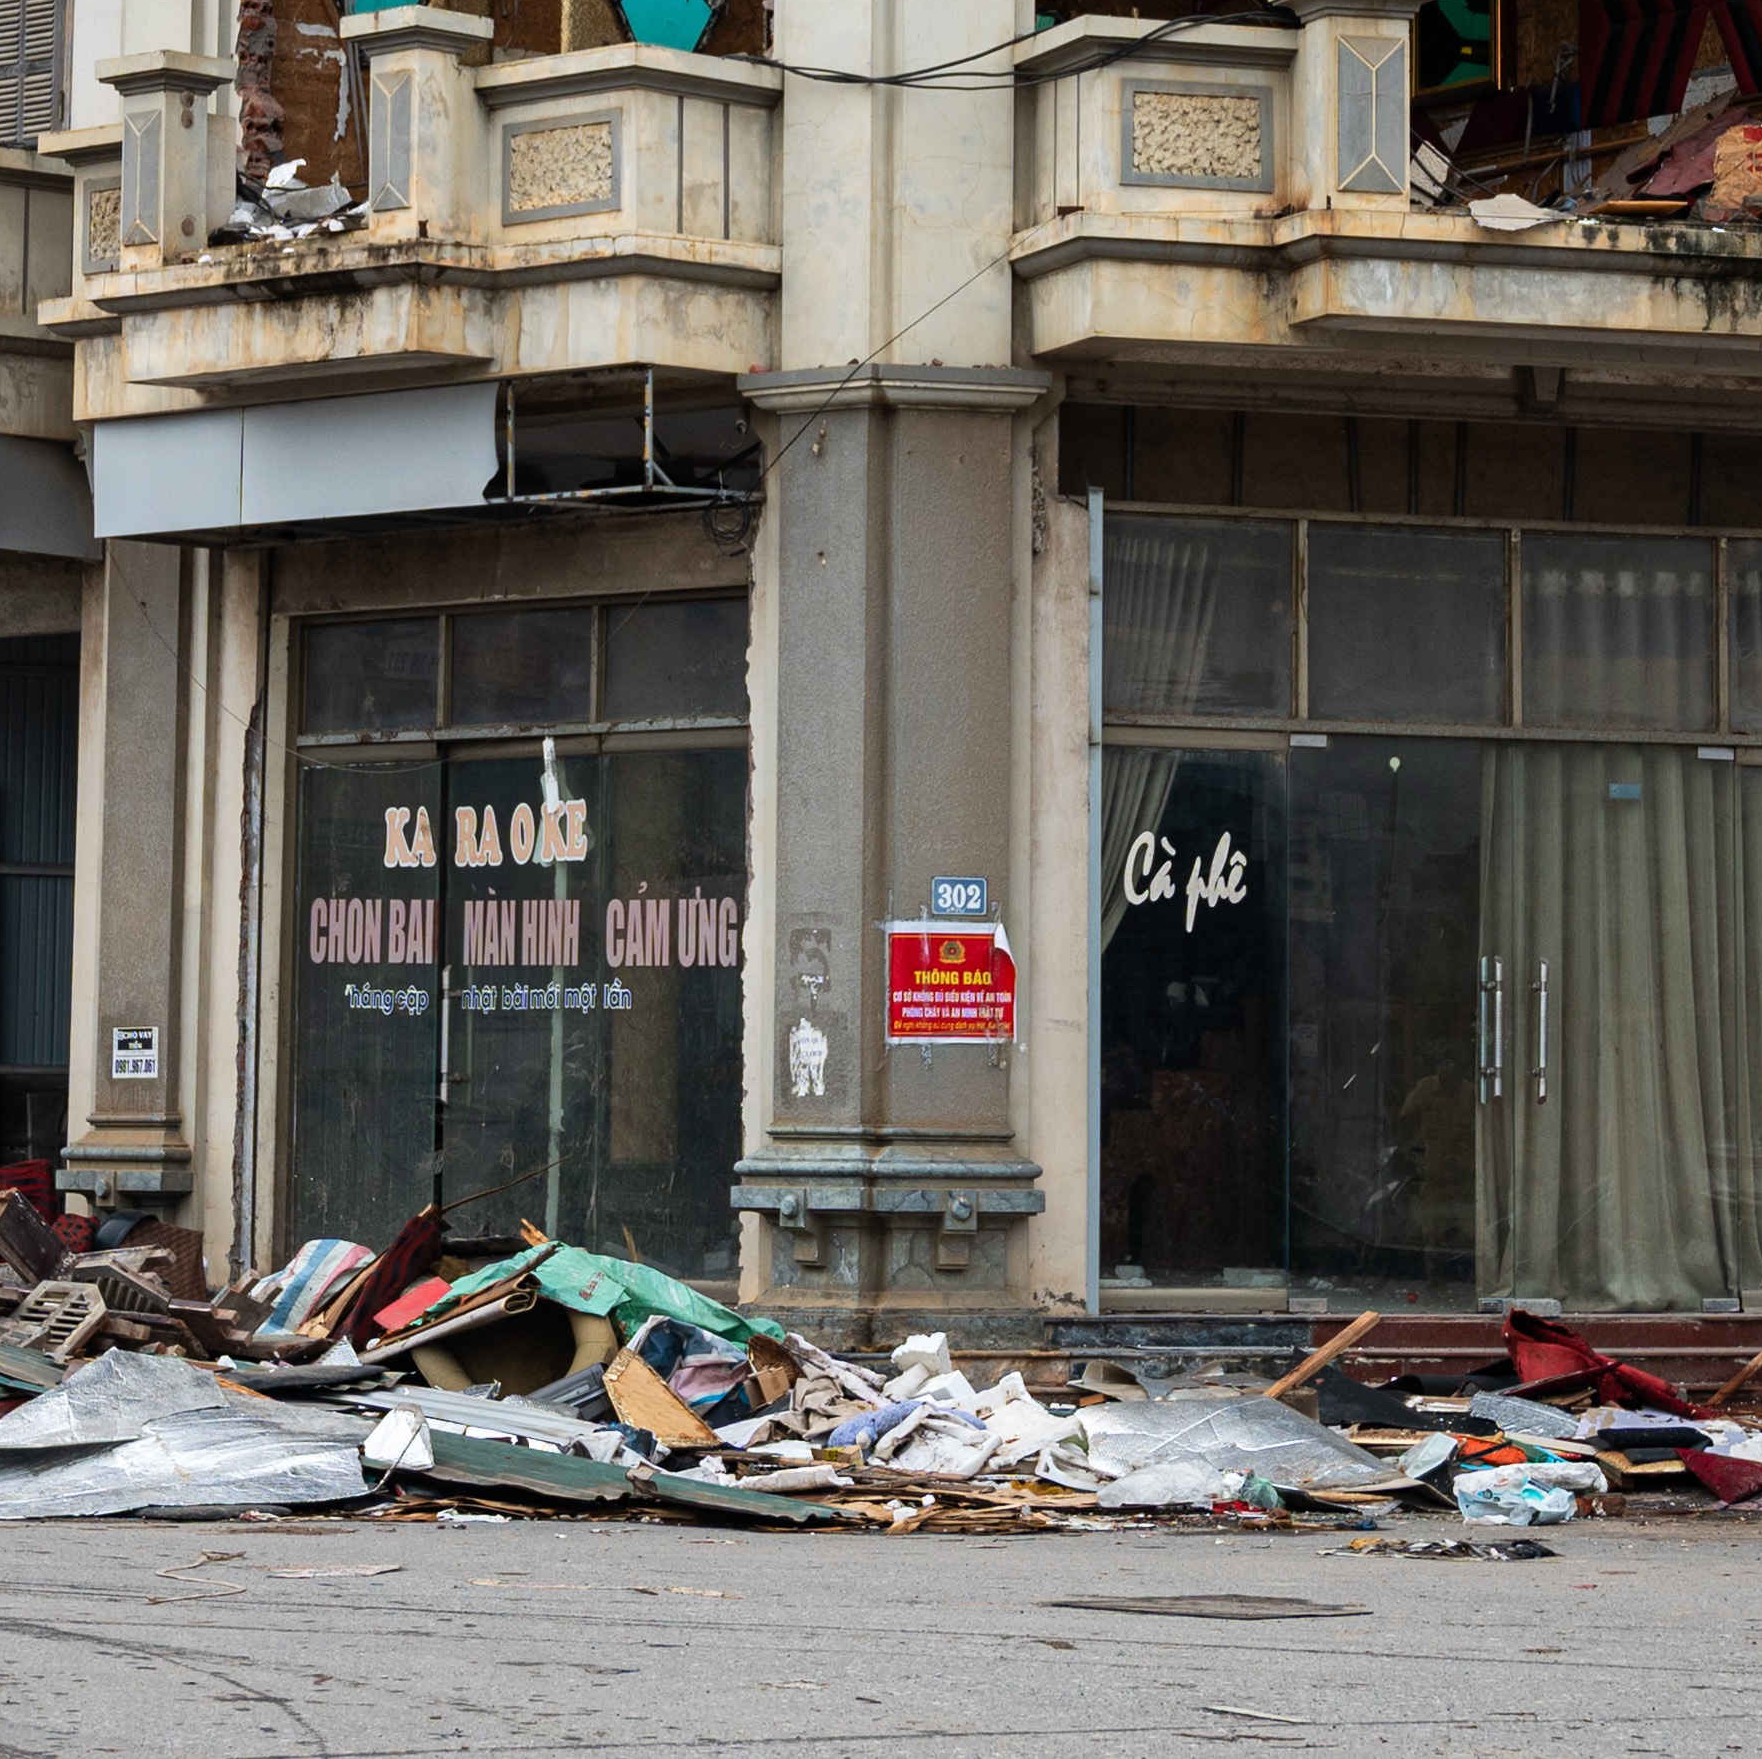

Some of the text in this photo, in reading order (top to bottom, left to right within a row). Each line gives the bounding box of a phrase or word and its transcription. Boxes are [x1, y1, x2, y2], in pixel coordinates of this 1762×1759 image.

[937, 883, 982, 909] 302
[1124, 830, 1247, 933] Cà phê
[310, 897, 383, 964] CHON
[521, 899, 580, 966] HINH
[914, 967, 992, 986] THÔNG BÁO
[345, 982, 394, 1015] háng
[395, 984, 429, 1015] cập
[461, 982, 498, 1015] nhật
[501, 981, 528, 1010] bài
[530, 980, 560, 1010] mới
[564, 982, 597, 1014] một
